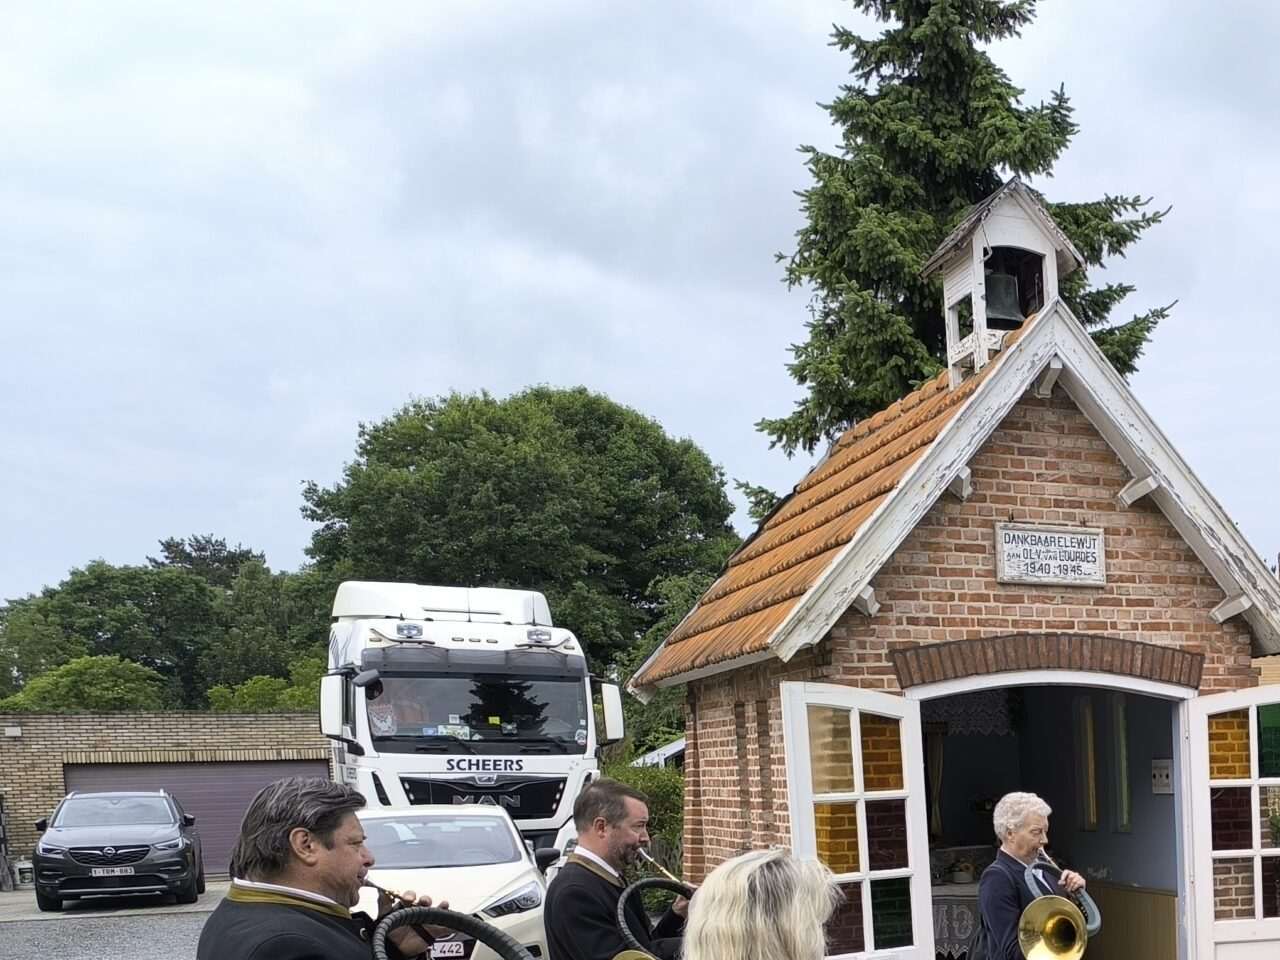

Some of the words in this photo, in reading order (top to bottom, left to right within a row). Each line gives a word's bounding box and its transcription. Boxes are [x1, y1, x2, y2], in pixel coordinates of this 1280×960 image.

[1004, 533, 1056, 547] DANKBAAR
[1058, 549, 1097, 563] LOURDES
[446, 758, 524, 771] SCHEERS
[452, 795, 521, 807] MAN
